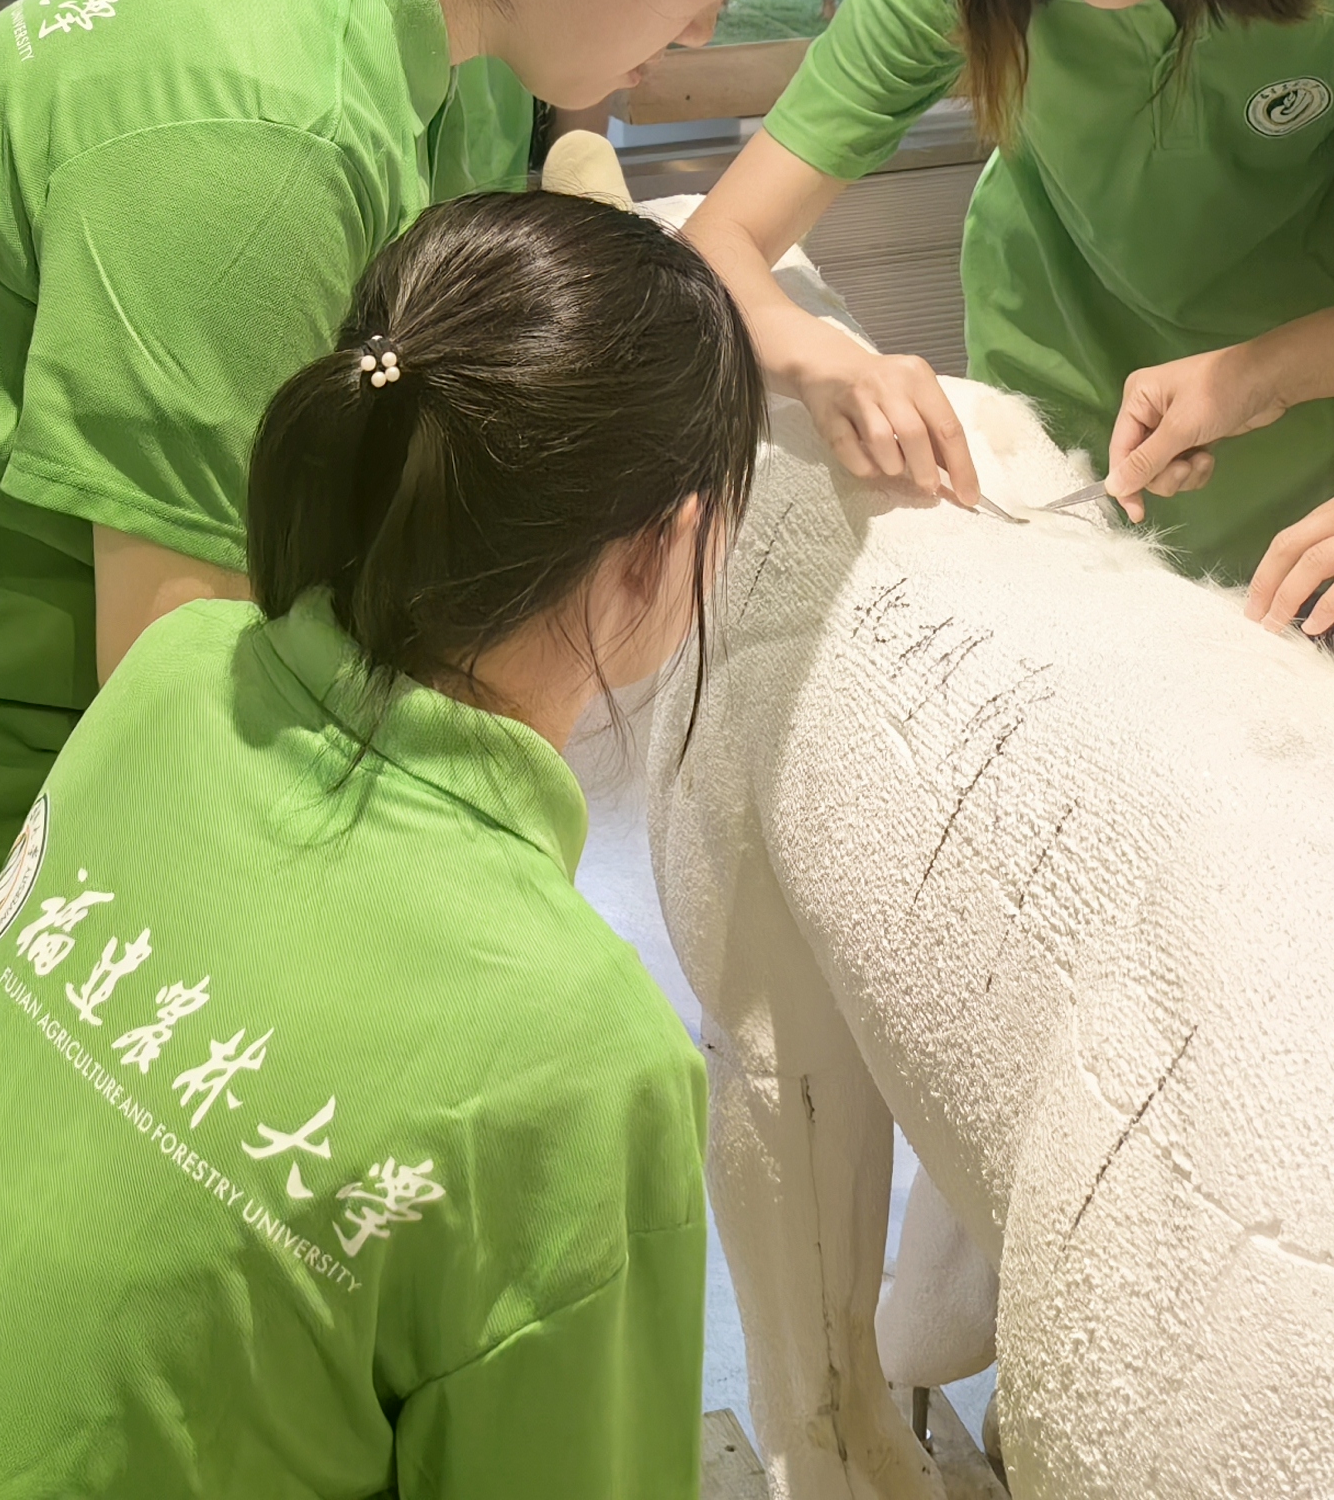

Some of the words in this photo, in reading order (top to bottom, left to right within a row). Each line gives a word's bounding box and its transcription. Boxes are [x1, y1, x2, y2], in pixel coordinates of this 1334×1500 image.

[37, 1011, 124, 1105] AGRICULTURE
[117, 1095, 153, 1134] AND
[151, 1123, 244, 1206] FORESTRY
[242, 1199, 362, 1292] UNIVERSITY
